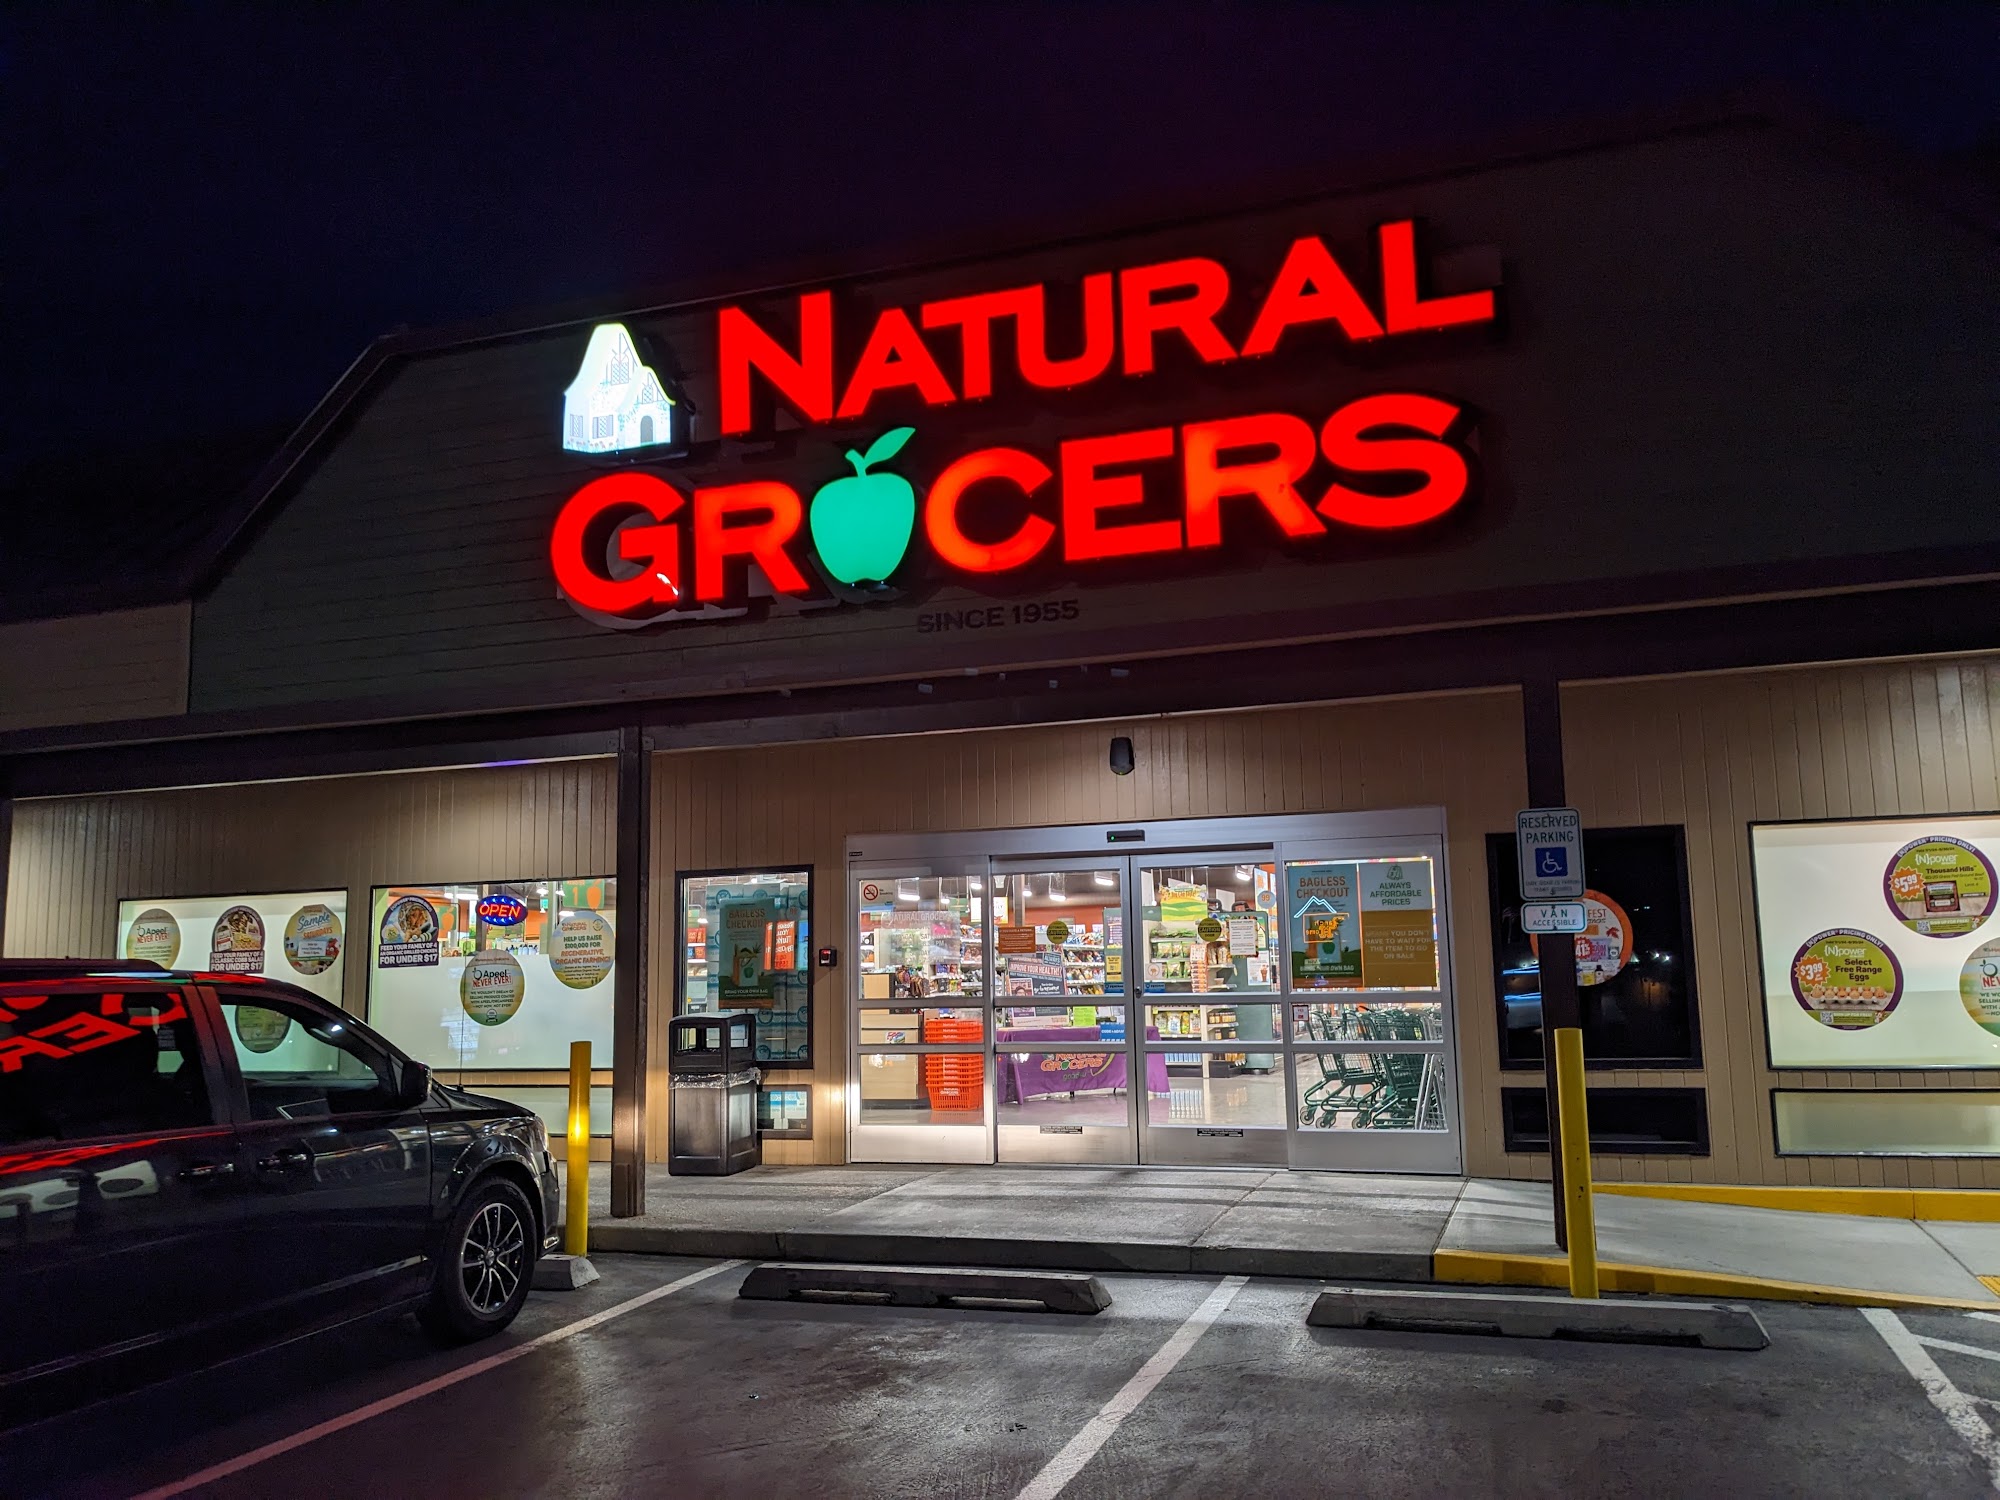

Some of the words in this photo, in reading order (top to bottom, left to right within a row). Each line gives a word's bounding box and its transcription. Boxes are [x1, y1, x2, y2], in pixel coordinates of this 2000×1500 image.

[718, 219, 1496, 436] NATURAL
[917, 605, 1005, 634] SINCE
[1012, 599, 1079, 624] 1955
[1520, 814, 1578, 830] RESERVED
[1526, 830, 1574, 844] PARKING
[1958, 840, 1976, 853] ONLY!
[1300, 876, 1346, 887] BAGLESS
[572, 887, 579, 906] 1
[1296, 888, 1350, 898] CHECKOUT
[1370, 890, 1422, 898] AFFORDABLE
[480, 904, 520, 917] OPEN
[729, 908, 766, 918] BAGLESS
[1540, 909, 1568, 918] VAN
[297, 912, 330, 930] Sample
[888, 912, 920, 920] NATURAL
[726, 919, 764, 928] CHECKOU
[1532, 918, 1577, 927] ACCESSIBLE
[137, 935, 153, 943] NEVER
[1839, 929, 1865, 938] PRICING
[1866, 934, 1883, 948] ONLY!
[396, 955, 423, 963] UNDER
[483, 969, 507, 978] Apeel
[1856, 966, 1882, 974] Range
[472, 977, 492, 987] NEVER
[494, 976, 512, 984] EVER!
[1849, 973, 1870, 982] Eggs
